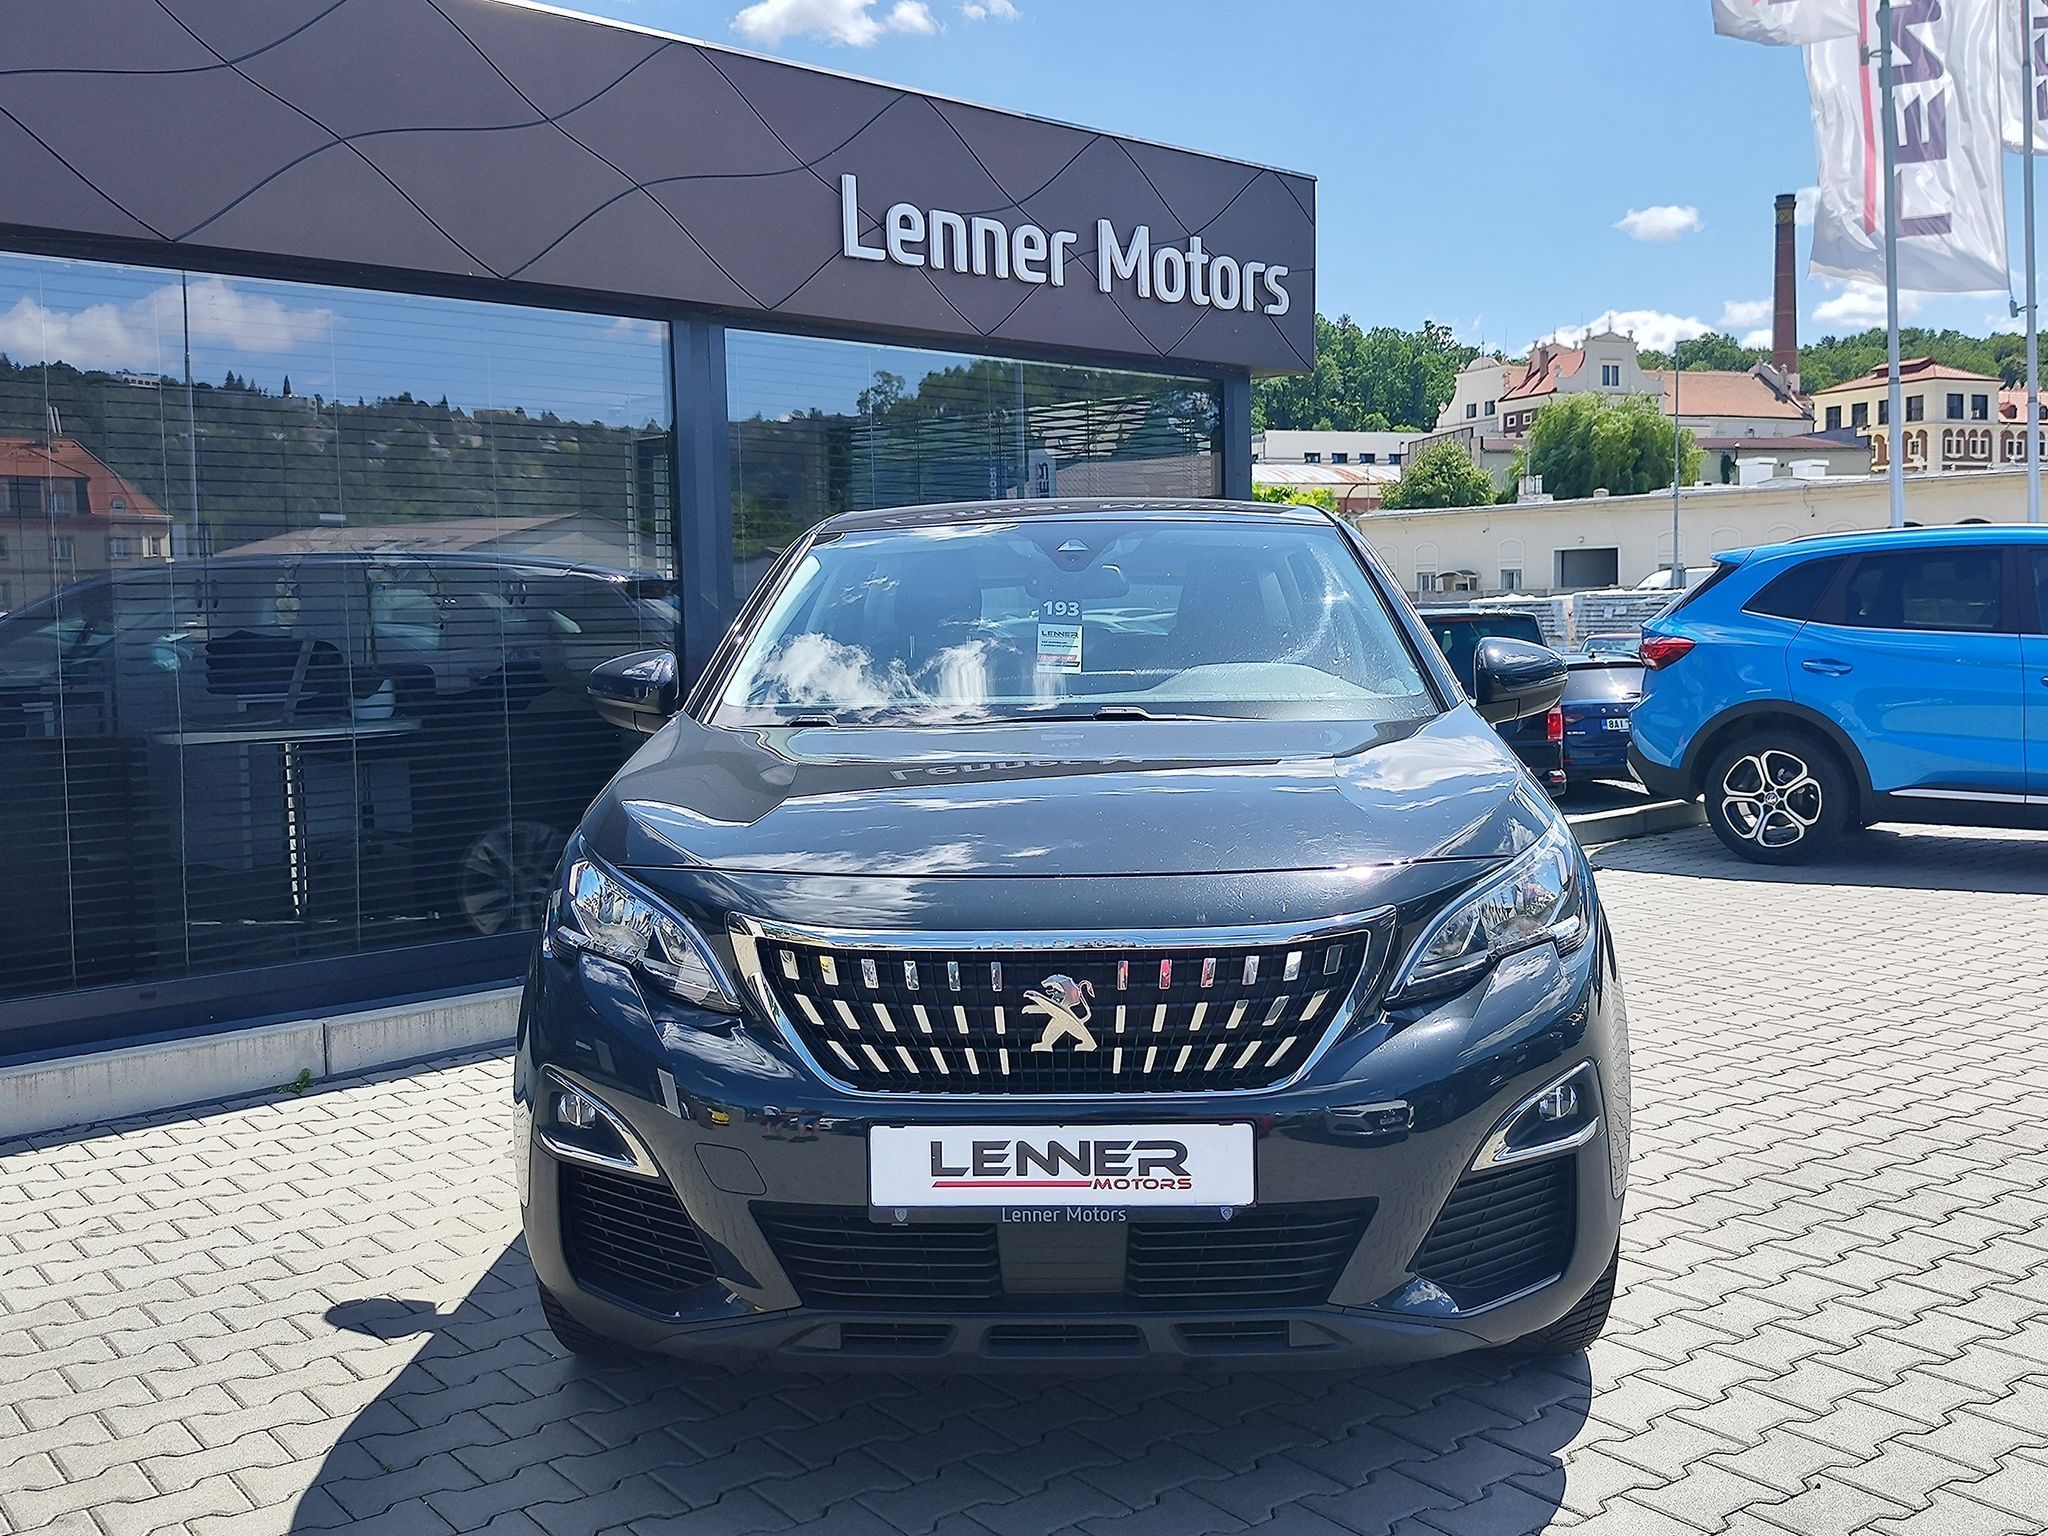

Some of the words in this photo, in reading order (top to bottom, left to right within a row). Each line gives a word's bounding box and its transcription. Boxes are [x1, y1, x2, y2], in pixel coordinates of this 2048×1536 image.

[841, 174, 1078, 287] Lenner
[1096, 218, 1291, 315] Motors
[1043, 600, 1080, 616] 193
[1041, 630, 1079, 639] LENNER
[930, 1140, 1192, 1176] LENNER
[1092, 1178, 1193, 1190] MOTORS
[1002, 1207, 1060, 1222] Lenner
[1066, 1206, 1127, 1222] Motors
